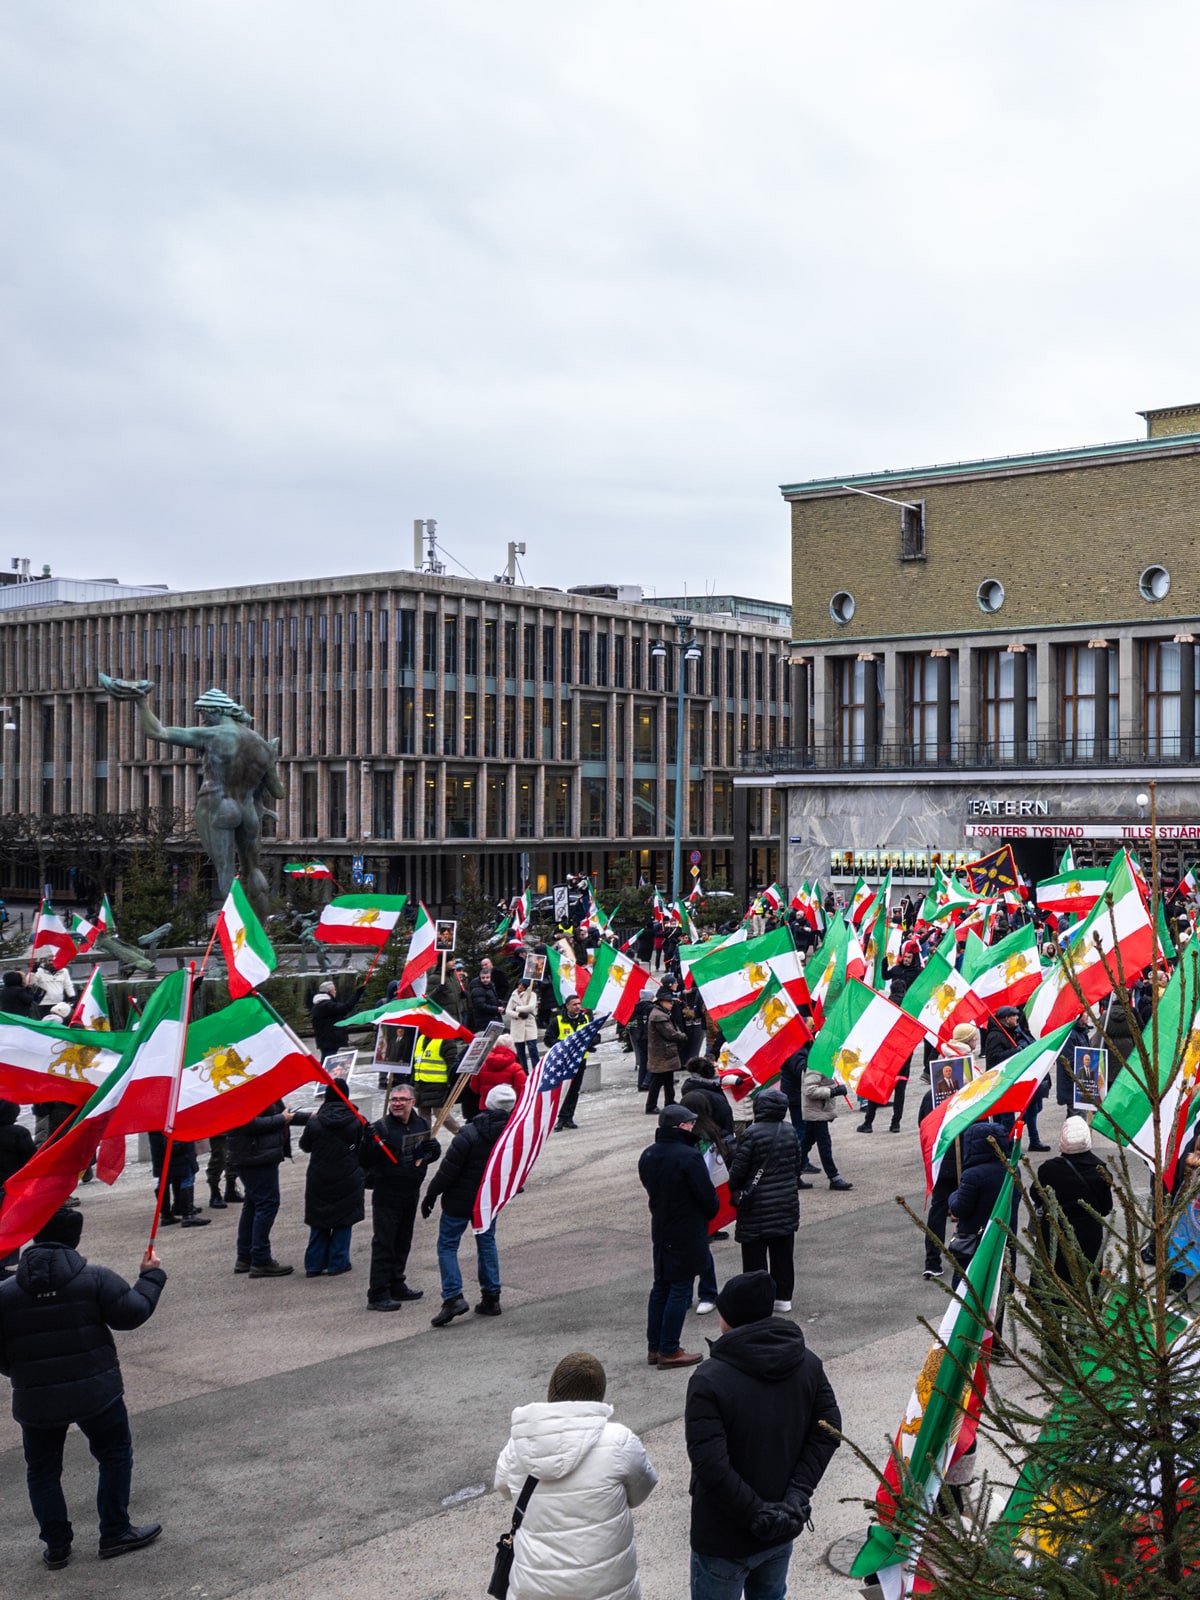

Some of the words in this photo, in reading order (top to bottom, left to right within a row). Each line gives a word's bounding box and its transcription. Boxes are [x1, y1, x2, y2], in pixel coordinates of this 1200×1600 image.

[978, 826, 1028, 838] SORTERS
[1032, 826, 1084, 838] TYSTNAD
[1121, 826, 1153, 838] TILLS
